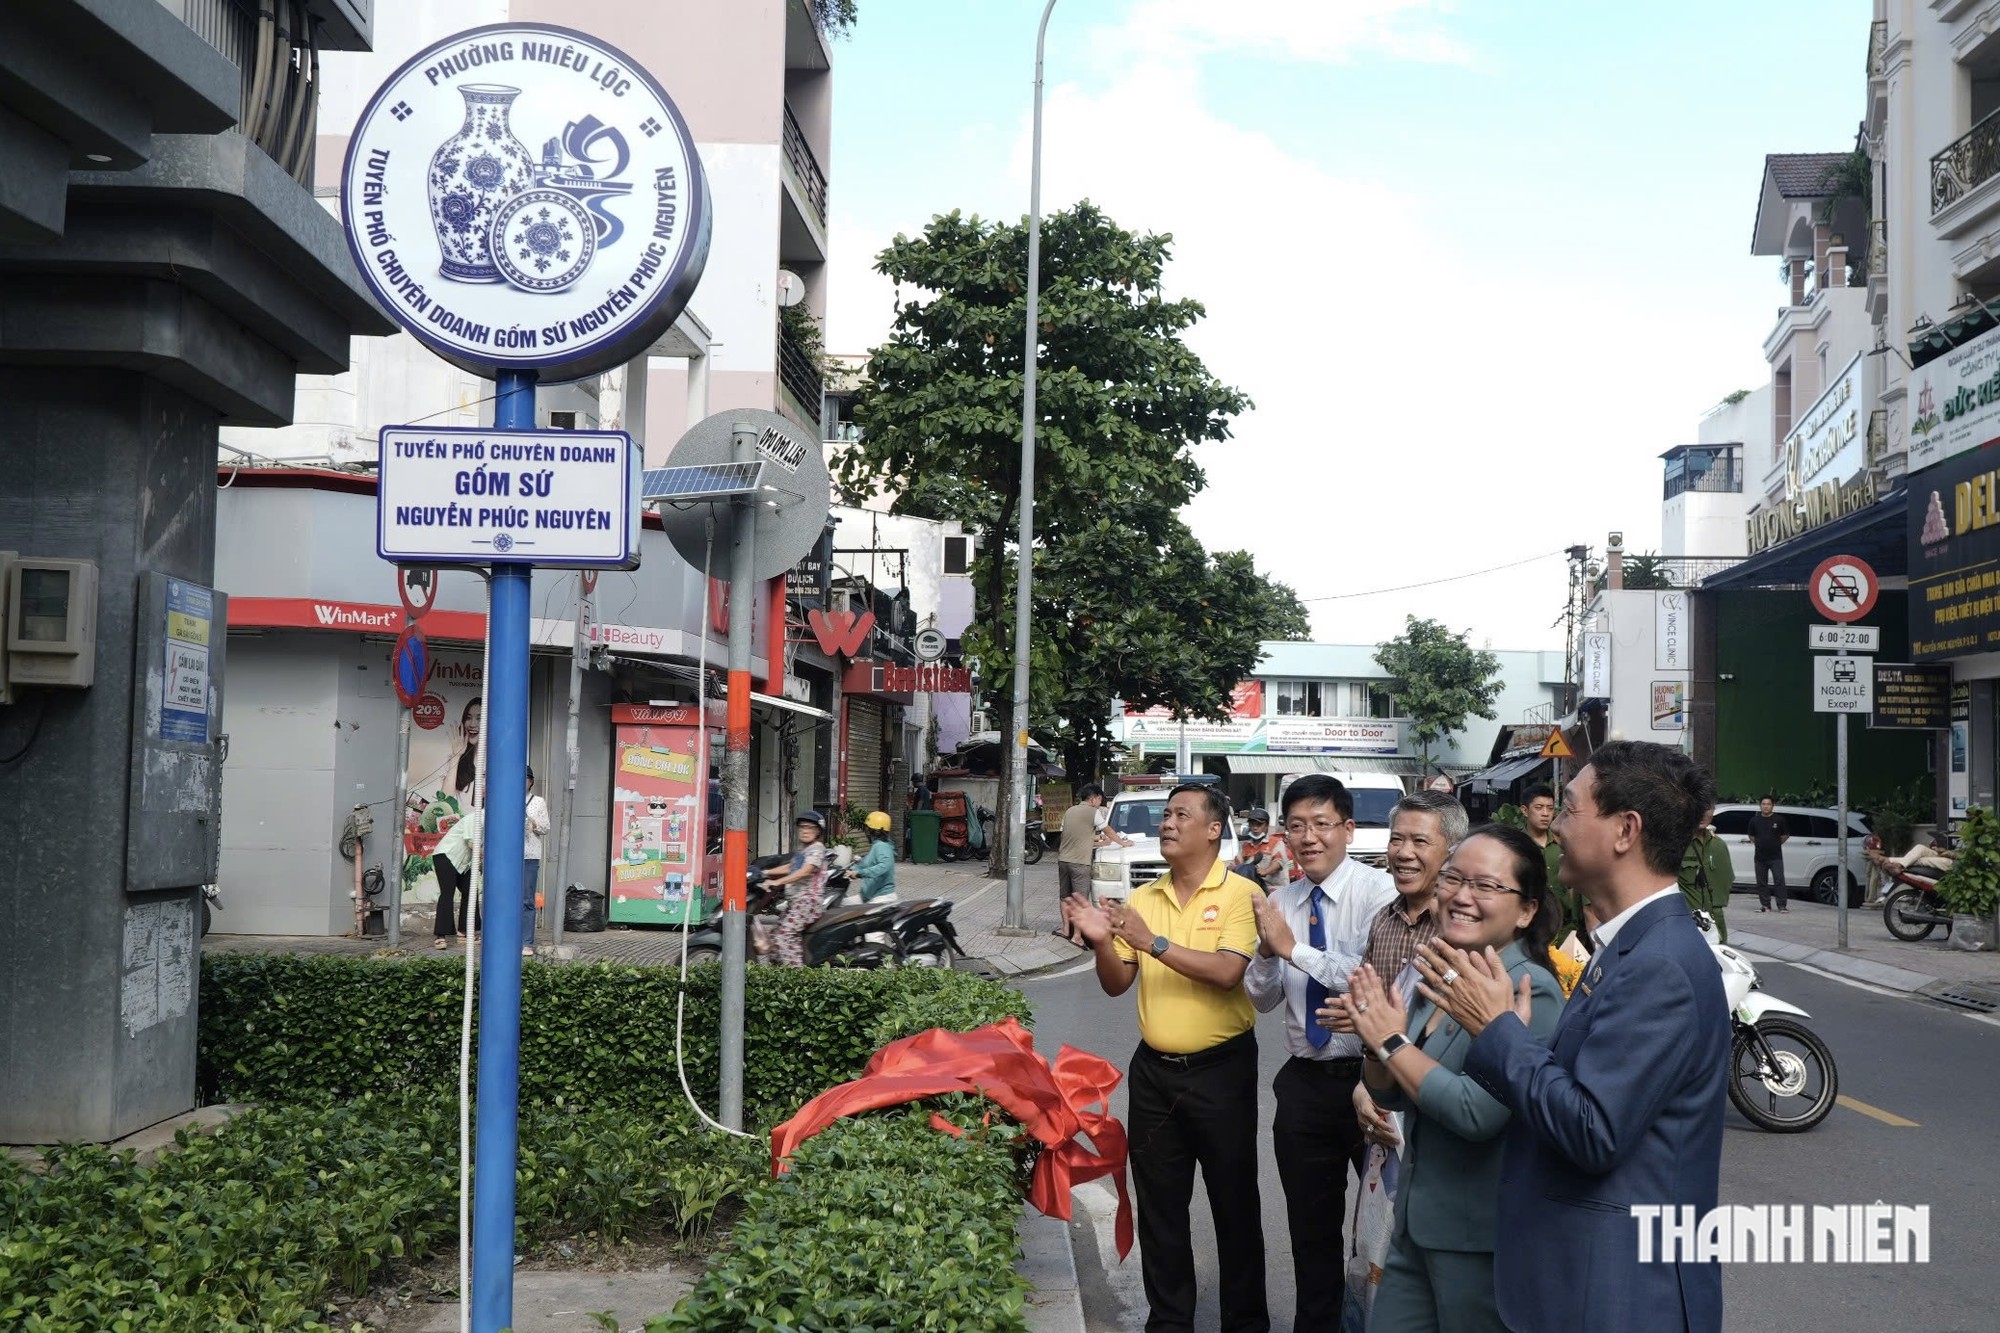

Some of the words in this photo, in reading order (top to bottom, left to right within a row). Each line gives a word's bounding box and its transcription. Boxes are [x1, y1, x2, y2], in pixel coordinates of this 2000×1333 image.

[424, 41, 514, 86] PHƯỜNG
[521, 42, 590, 73] NHIÊU
[590, 61, 632, 98] LỘC
[363, 147, 390, 205] TUYẾN
[653, 165, 678, 240] NGUYÊN
[364, 211, 396, 248] PHỐ
[376, 247, 432, 315] CHUYÊN
[633, 244, 668, 289] PHÚC
[428, 301, 489, 347] DOANH
[570, 284, 638, 342] NGUYỄN
[494, 323, 537, 349] GỐM
[543, 322, 571, 348] SỨ
[1960, 360, 1983, 378] CÔNG
[1984, 350, 1996, 367] TY
[1943, 384, 1976, 422] ĐỨC
[395, 439, 446, 459] TUYẾN
[452, 440, 484, 460] PHỐ
[490, 443, 555, 462] CHUYÊN
[560, 446, 615, 463] DOANH
[455, 463, 510, 496] GỐM
[519, 470, 554, 497] SỨ
[396, 502, 472, 527] NGUYỄN
[479, 505, 529, 528] PHÚC
[535, 508, 611, 530] NGUYÊN
[1805, 477, 1841, 530] MAI
[1841, 475, 1878, 513] Hotel
[1955, 471, 2000, 536] DEL
[807, 561, 822, 571] BAY
[611, 629, 664, 649] Beauty
[1821, 685, 1851, 698] NGOẠI
[1853, 684, 1866, 698] LỆ
[1877, 670, 1903, 682] DELTA
[415, 704, 441, 716] 20%
[1827, 699, 1858, 710] Except
[1325, 728, 1347, 736] Door
[1349, 728, 1359, 736] to
[1361, 729, 1384, 737] Door
